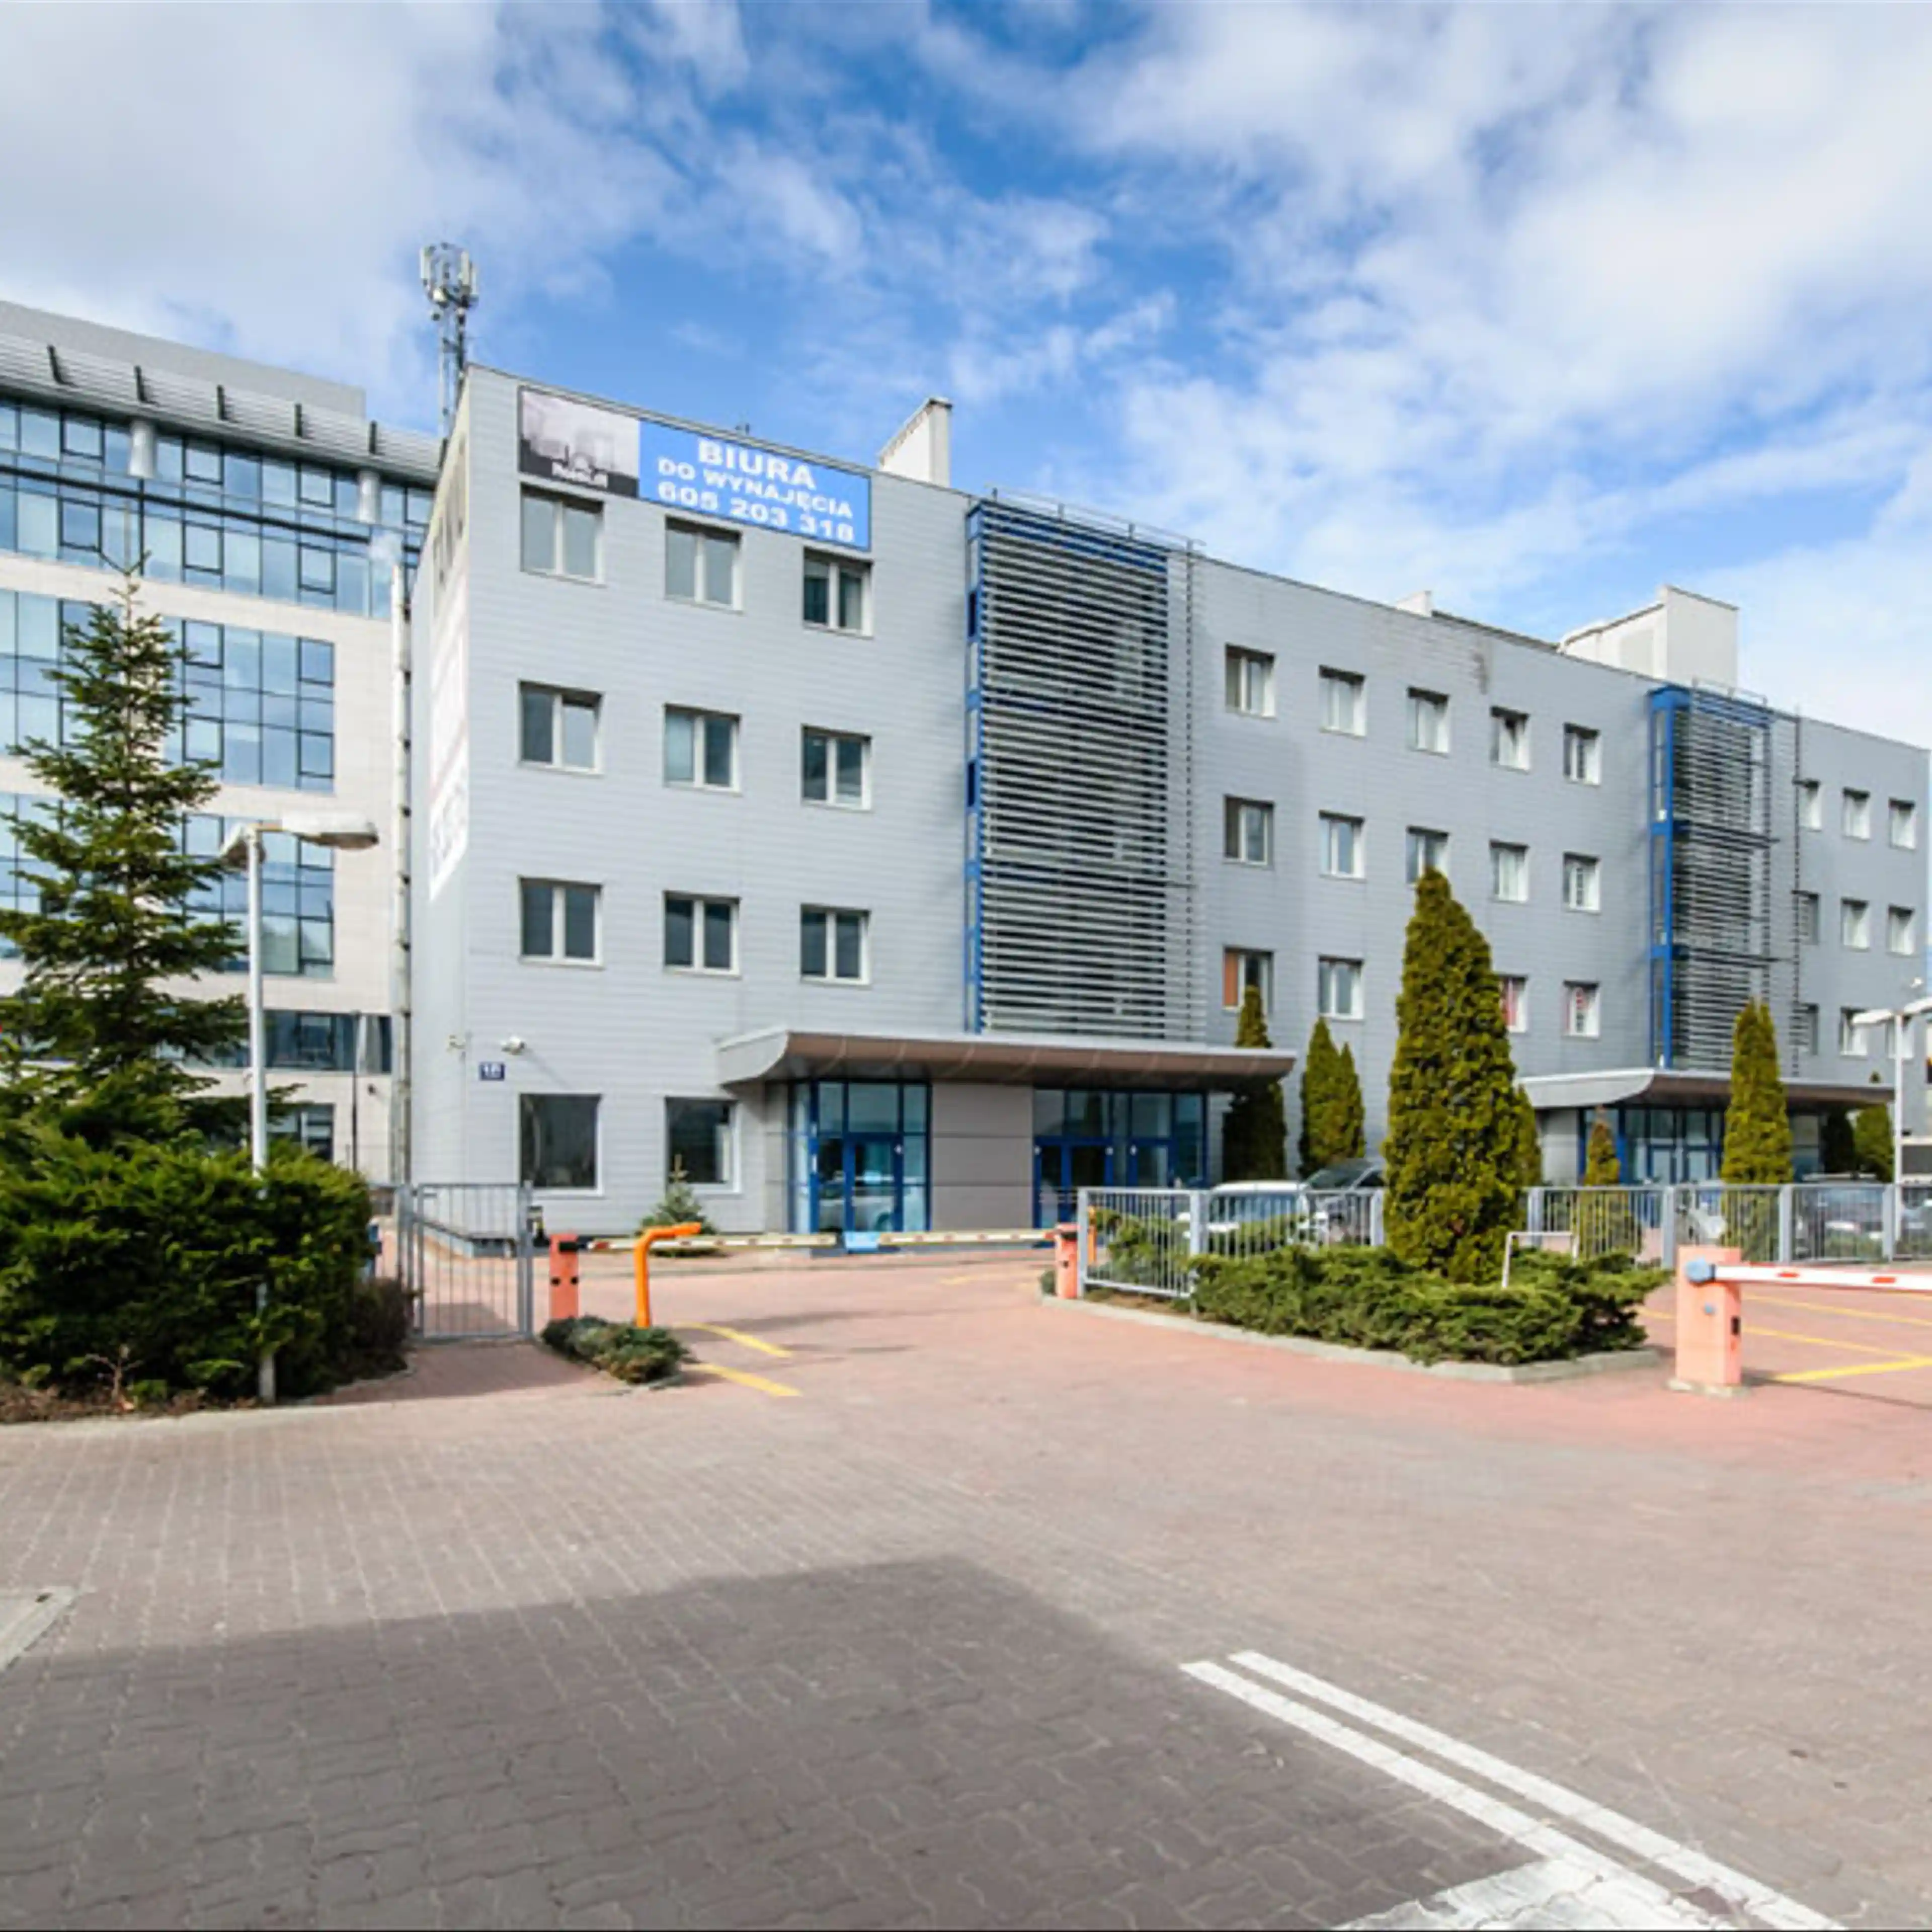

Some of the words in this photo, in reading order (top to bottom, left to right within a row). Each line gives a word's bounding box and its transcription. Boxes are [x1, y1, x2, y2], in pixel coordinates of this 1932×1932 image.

[658, 457, 695, 480] DO
[698, 439, 816, 490] BIURA
[730, 496, 788, 527] 203
